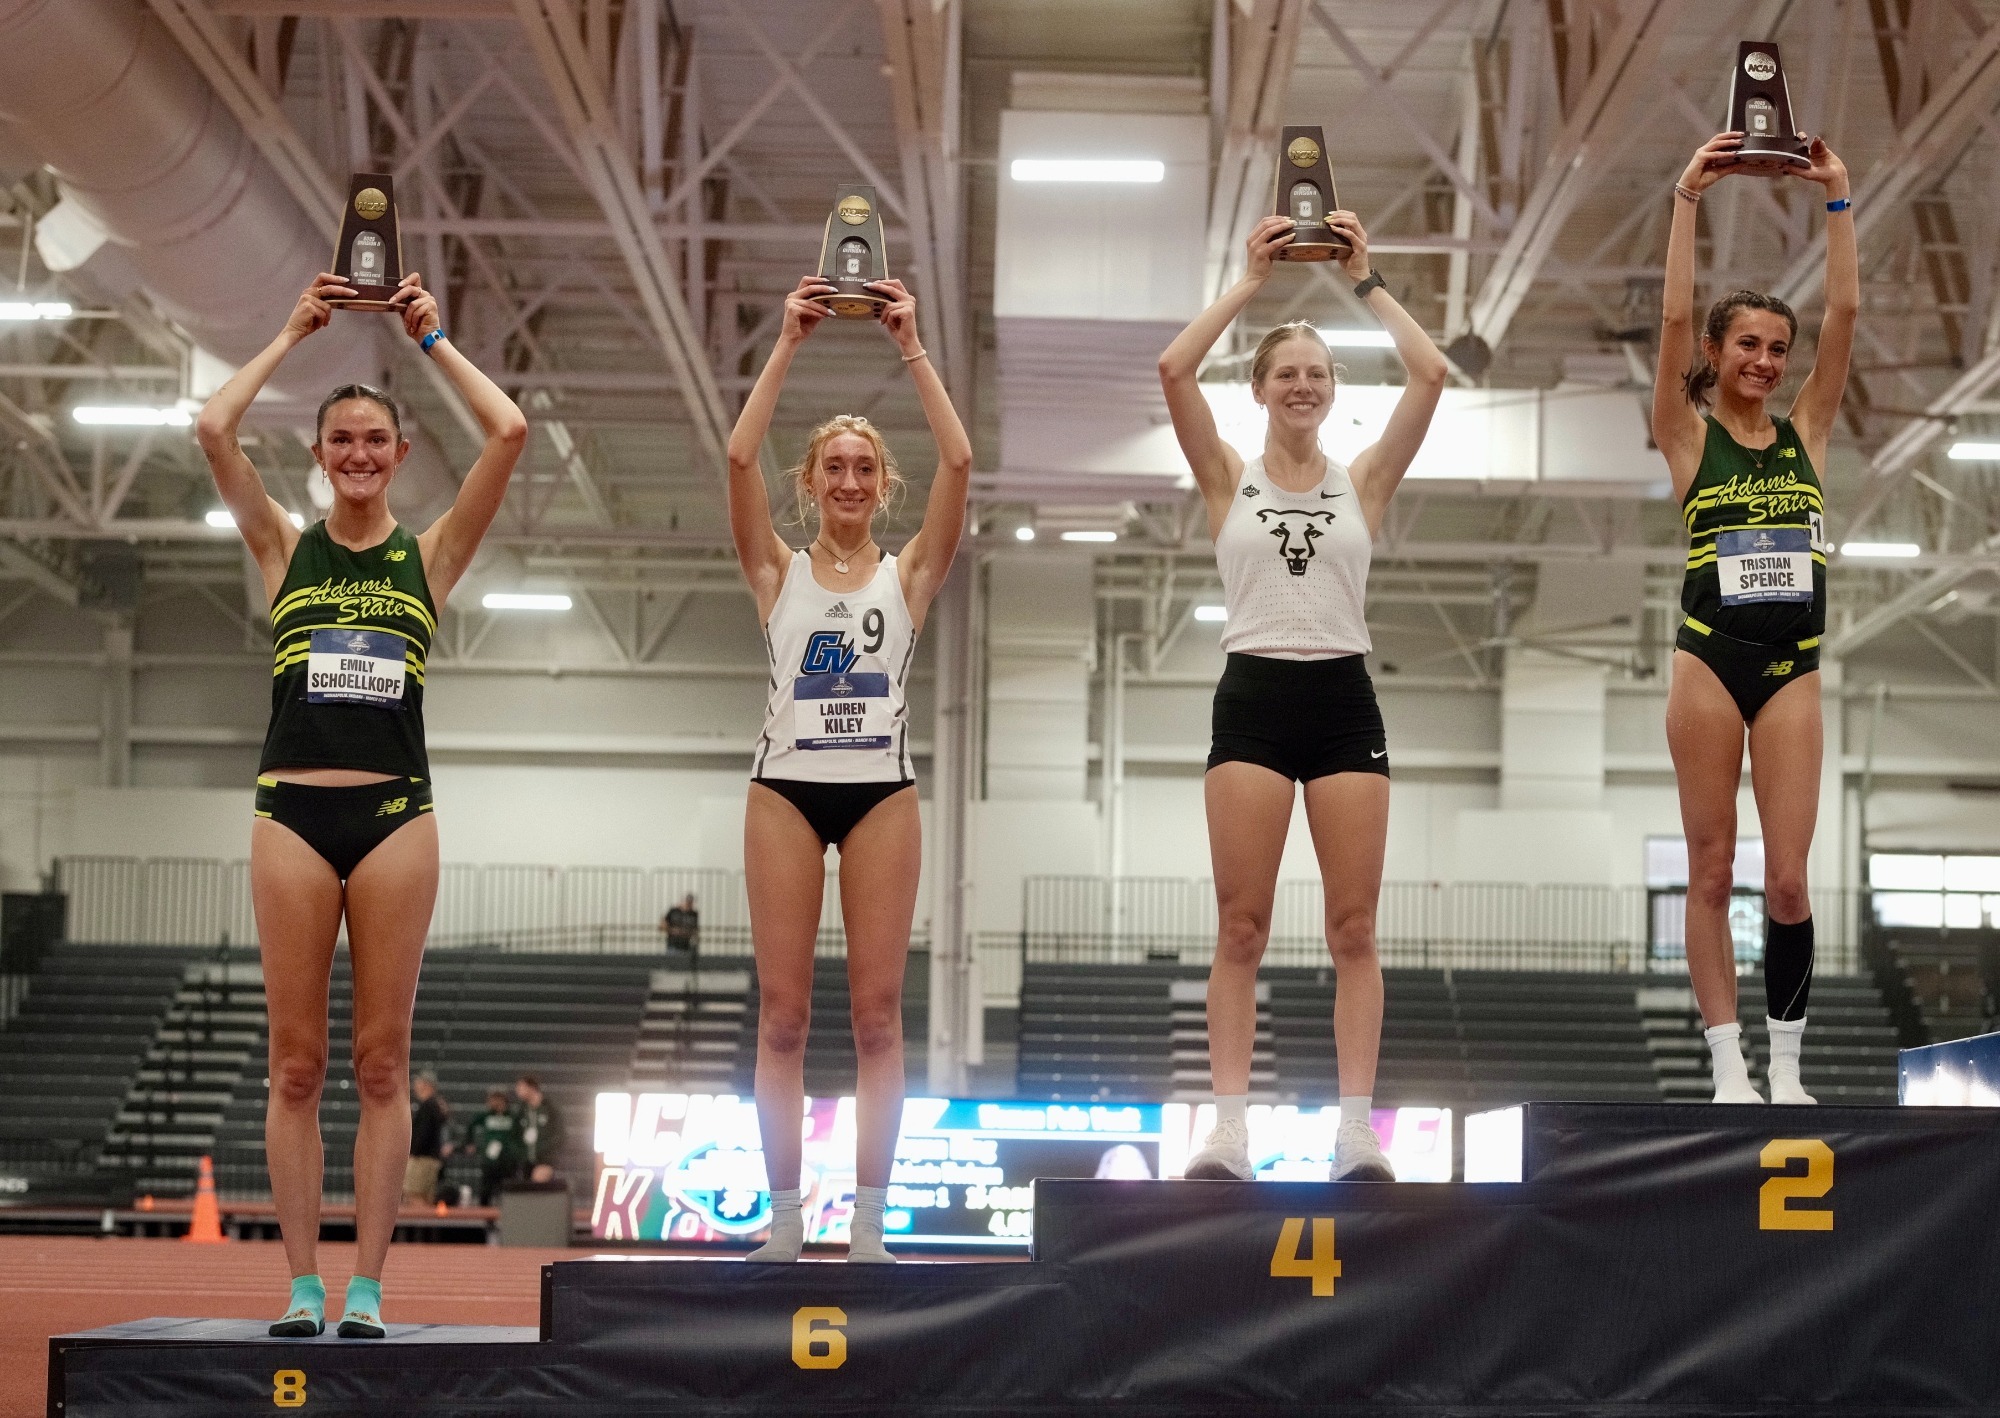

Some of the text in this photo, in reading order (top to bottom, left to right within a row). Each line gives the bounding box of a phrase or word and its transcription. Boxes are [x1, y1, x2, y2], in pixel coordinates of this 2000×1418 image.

[1747, 64, 1775, 74] NCAA
[357, 201, 386, 212] NCAA
[841, 208, 870, 217] NCAA
[1715, 470, 1798, 507] Adams
[1747, 492, 1809, 524] State
[1740, 557, 1791, 572] TRISTIAN
[306, 576, 393, 607] Adams
[1739, 572, 1795, 590] SPENCE
[337, 598, 405, 623] State
[824, 611, 853, 619] adidas
[862, 608, 885, 654] 9
[340, 658, 375, 673] EMILY
[311, 672, 401, 694] SCHOELLKOPF
[820, 702, 866, 716] LAUREN
[824, 717, 863, 734] KILEY
[1760, 1139, 1834, 1231] 2
[1271, 1218, 1342, 1297] 4
[791, 1306, 847, 1369] 6
[273, 1369, 307, 1407] 8
